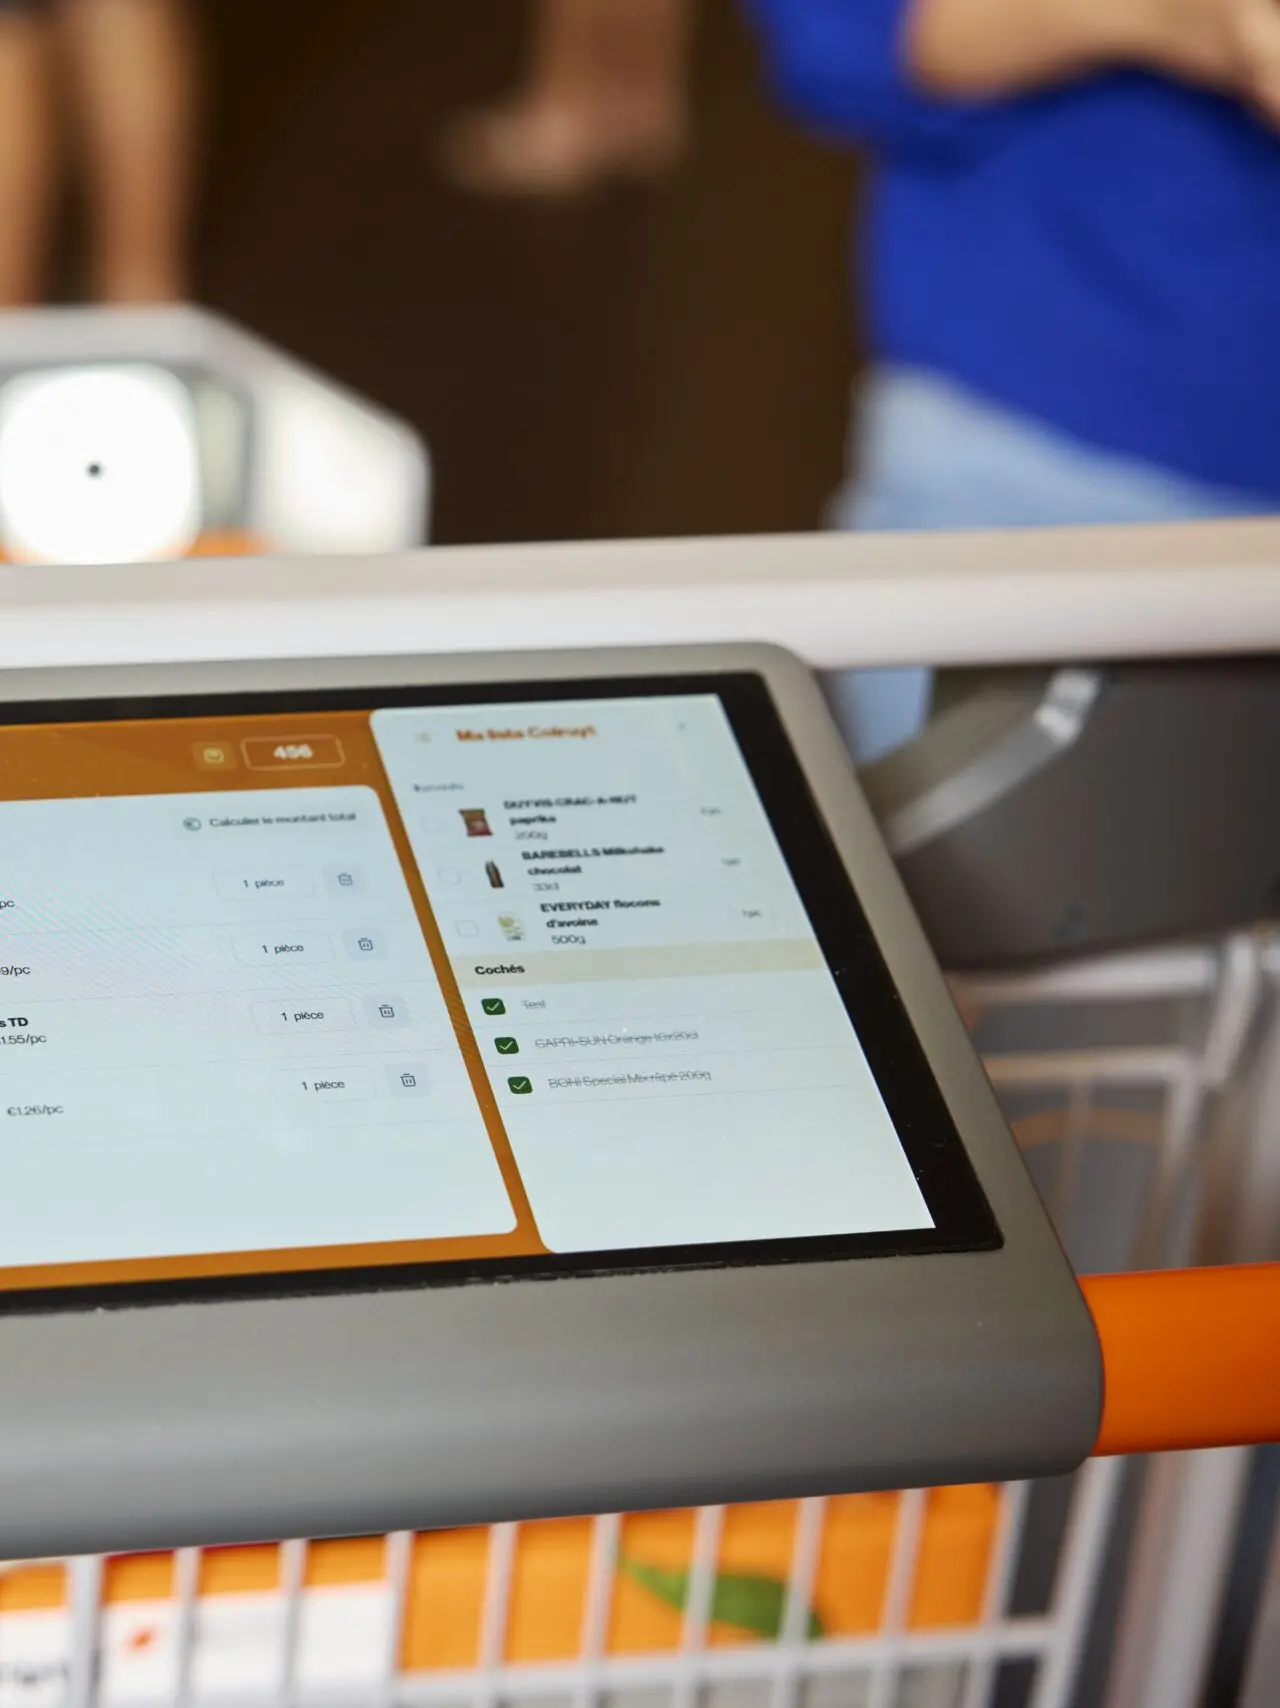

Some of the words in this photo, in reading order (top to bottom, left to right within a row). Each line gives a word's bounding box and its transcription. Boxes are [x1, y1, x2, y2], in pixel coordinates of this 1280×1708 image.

[209, 815, 259, 827] Calculer
[276, 812, 326, 823] montant
[328, 811, 356, 821] total
[528, 864, 582, 876] chocolat
[255, 877, 285, 889] pièce
[540, 899, 610, 914] EVERYDAY
[546, 918, 599, 929] d'avoine
[551, 933, 586, 946] 500g
[274, 943, 305, 955] pièce
[475, 964, 526, 976] Cochés
[281, 1011, 288, 1021] 1
[294, 1010, 325, 1022] pièce
[8, 1017, 29, 1028] TD
[302, 1081, 309, 1090] 1
[314, 1080, 346, 1092] pièce
